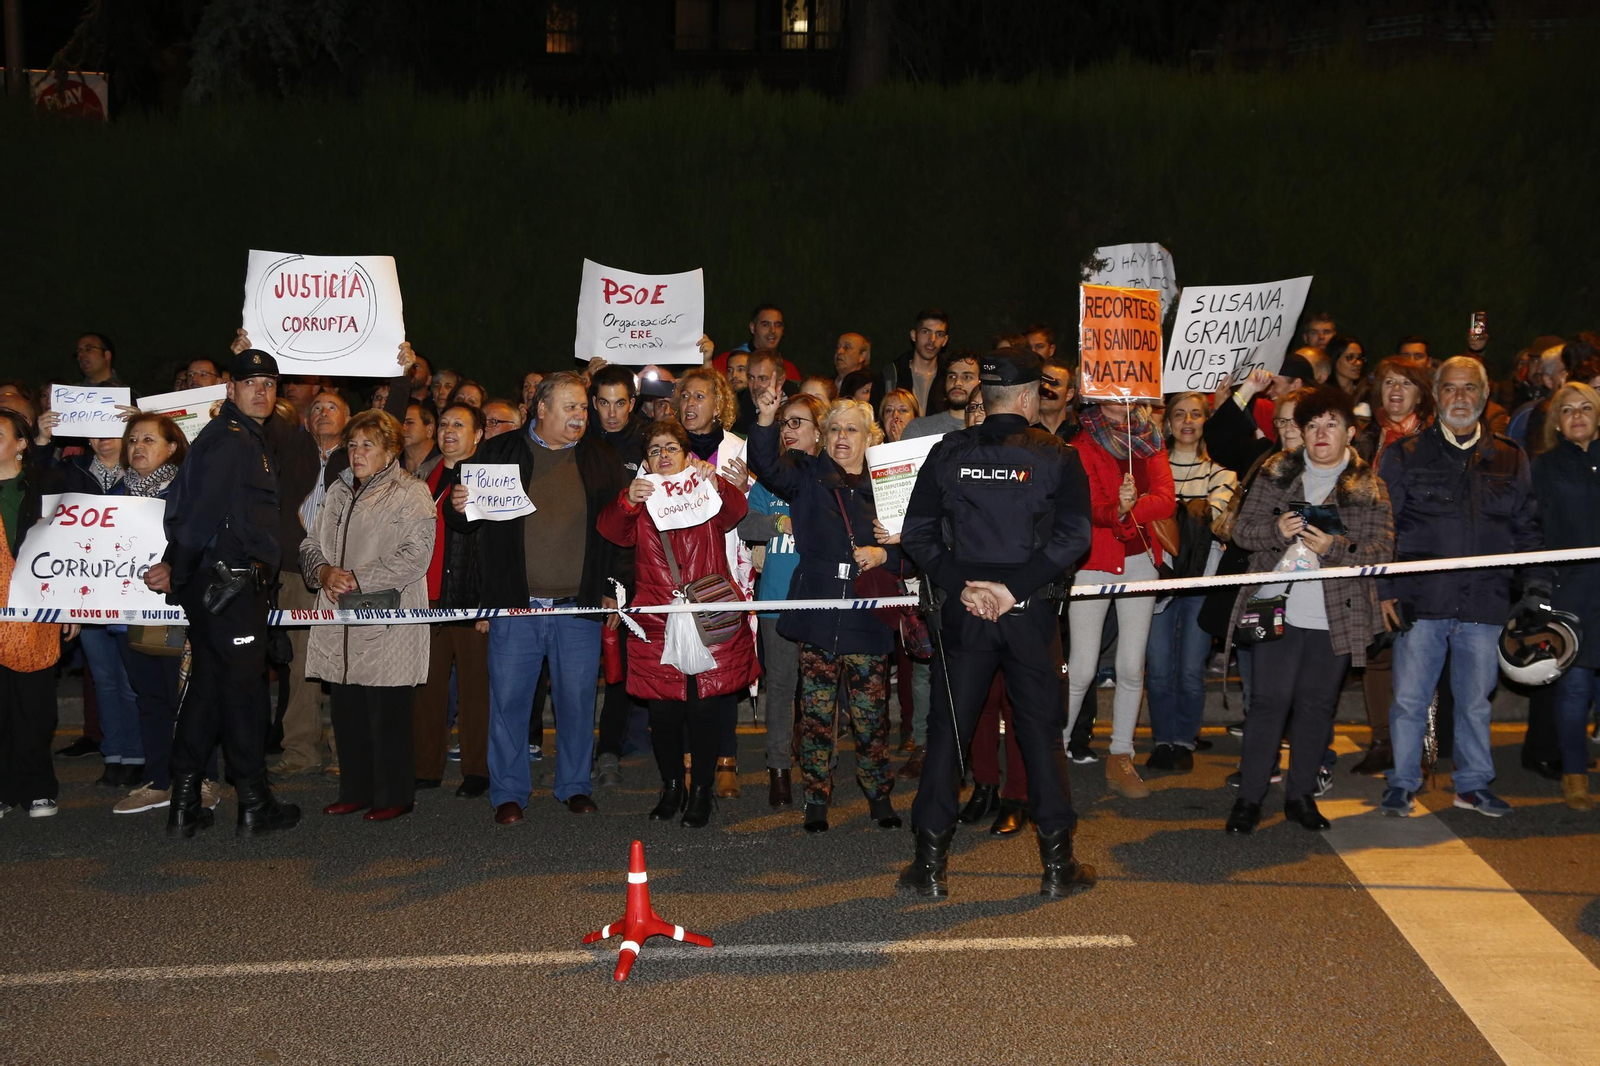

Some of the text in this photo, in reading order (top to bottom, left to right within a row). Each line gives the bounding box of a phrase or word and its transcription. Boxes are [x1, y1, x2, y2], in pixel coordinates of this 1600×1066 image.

[1122, 252, 1147, 269] HAY
[275, 270, 364, 298] JUSTICIA
[601, 277, 667, 304] PSOE
[1085, 296, 1156, 321] RECORTES
[282, 315, 358, 333] CORRUPTA
[630, 330, 653, 338] ERE
[1185, 314, 1282, 344] GRANADA
[1084, 328, 1158, 351] EN SANIDAD
[1171, 349, 1205, 371] NO
[1230, 346, 1258, 370] TU
[1084, 360, 1158, 384] MATAN.
[55, 387, 97, 403] PSOE
[662, 472, 699, 497] PSOE
[960, 468, 1018, 480] POLICIA
[657, 487, 710, 518] CORRUPCIÓN
[50, 503, 118, 527] PSOE
[291, 609, 319, 620] PASAR
